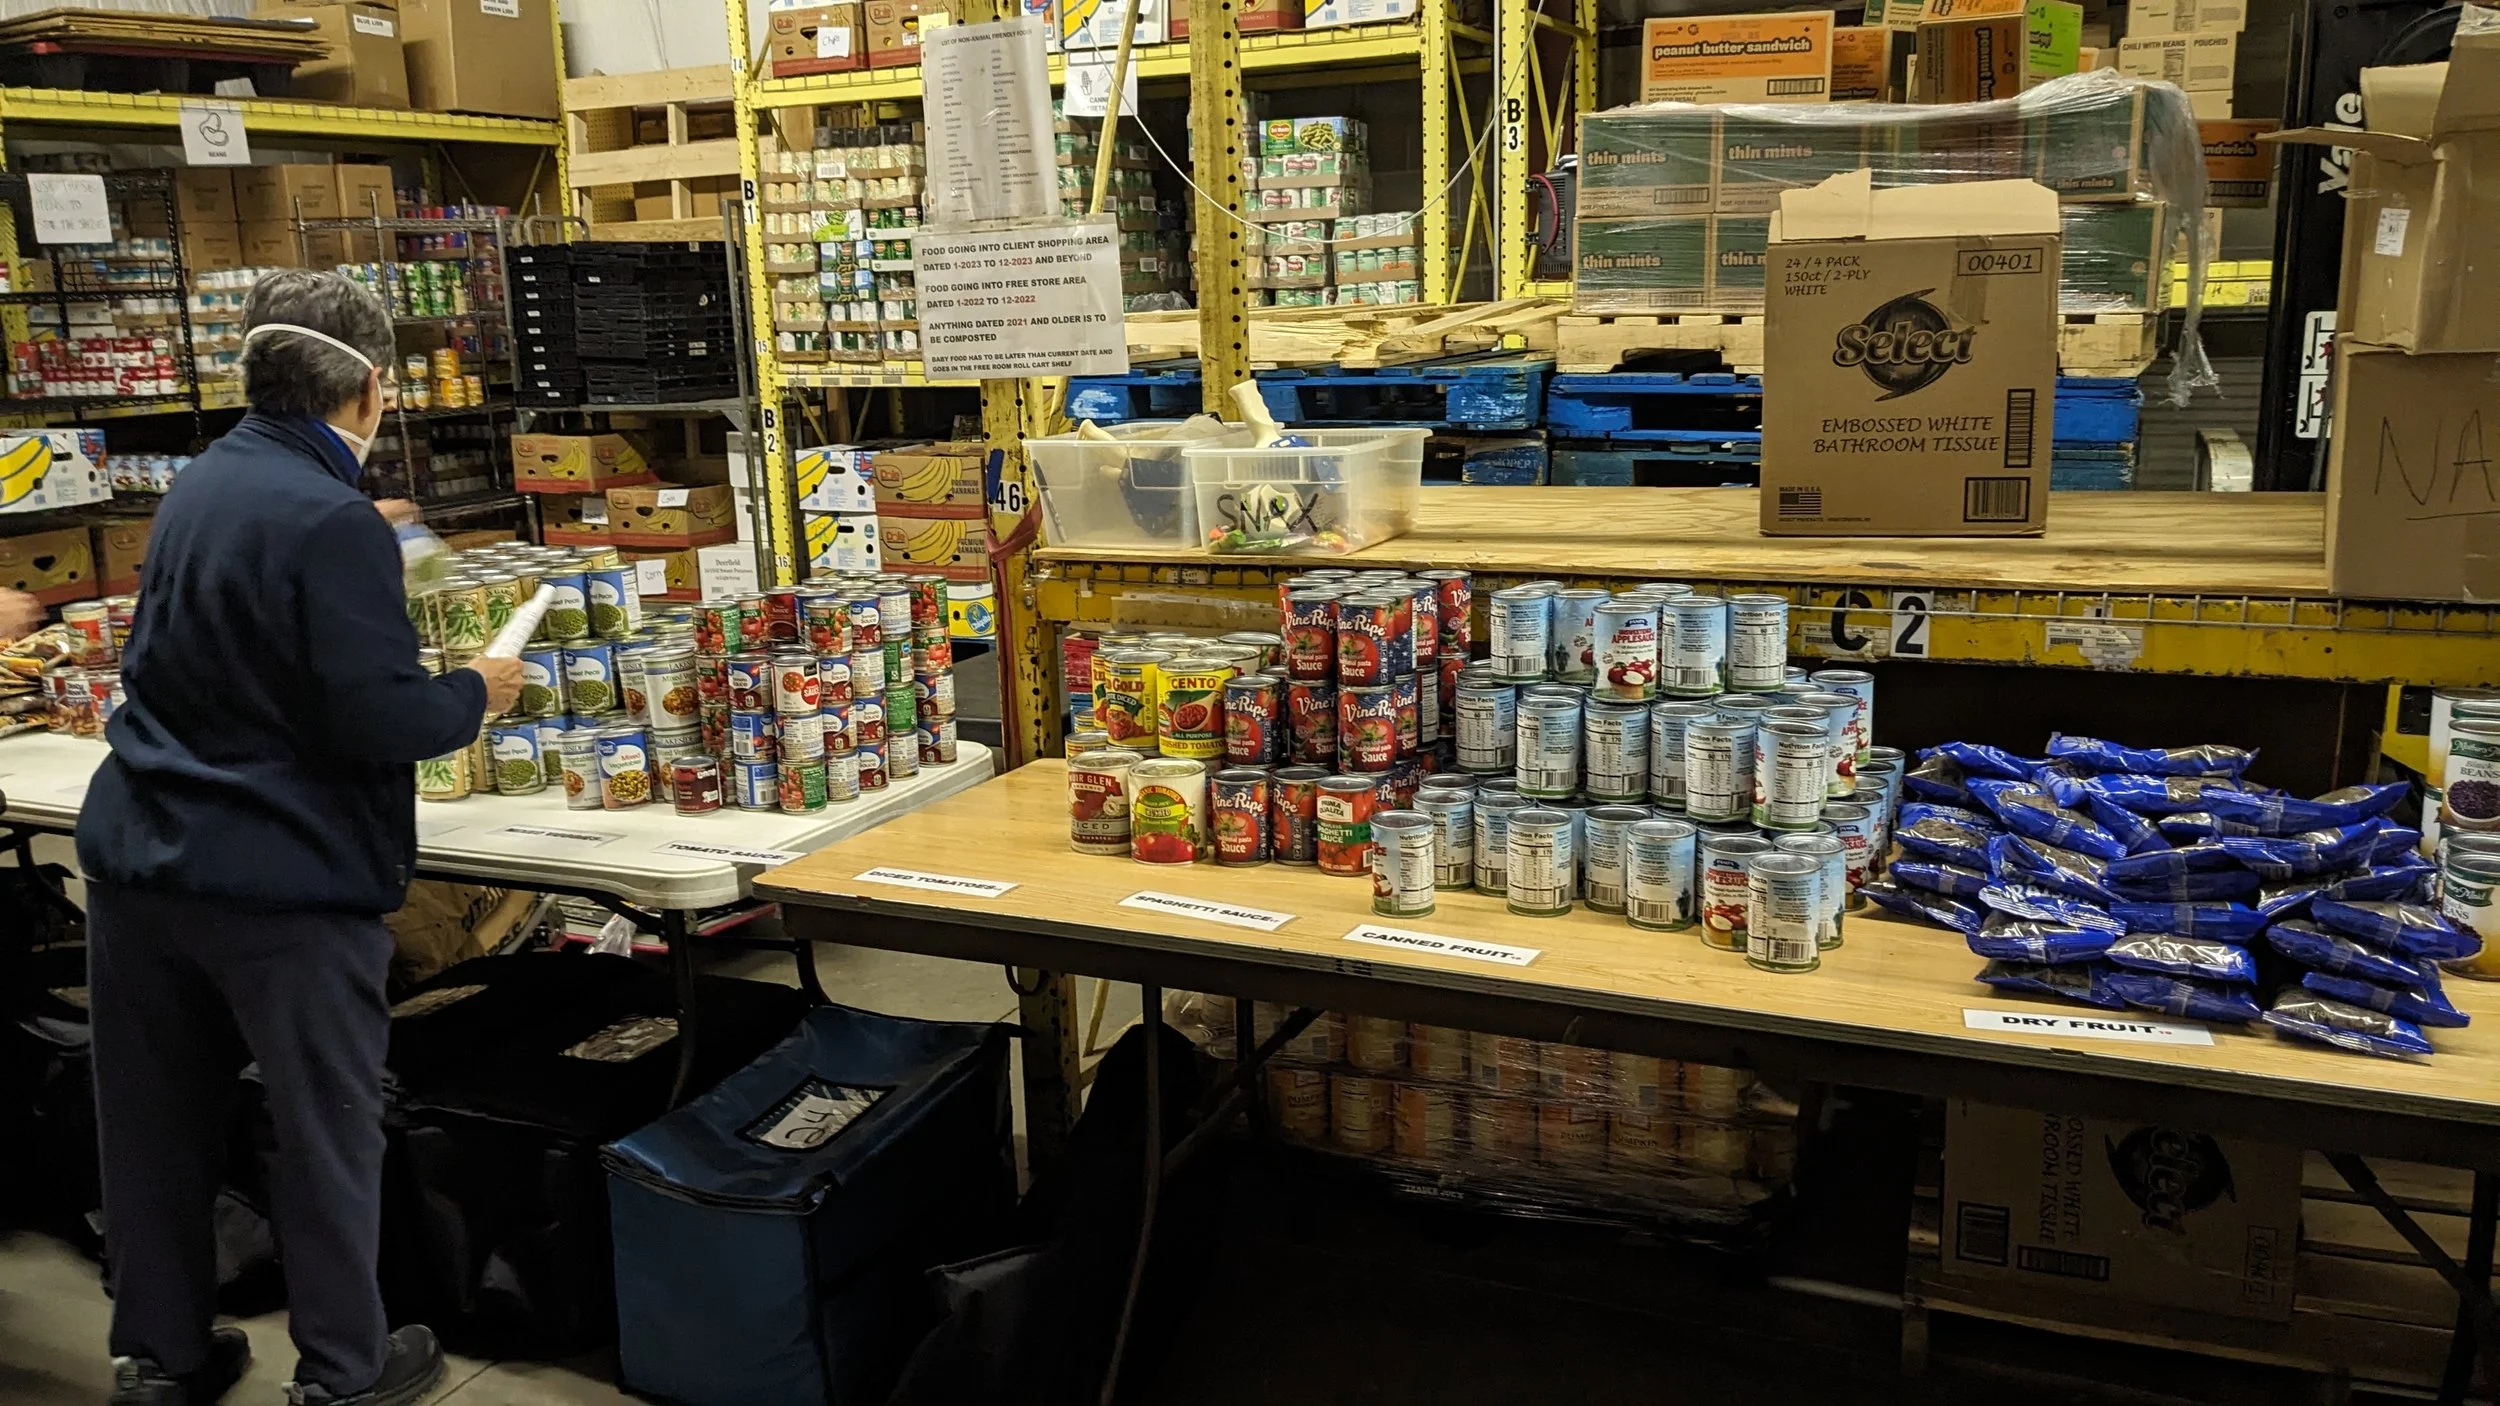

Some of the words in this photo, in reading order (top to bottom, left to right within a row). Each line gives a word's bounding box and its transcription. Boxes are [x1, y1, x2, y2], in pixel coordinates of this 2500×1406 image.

[958, 34, 991, 43] NON-ANIMAL
[992, 31, 1016, 39] FRIENDLY
[2194, 38, 2228, 48] POUCHED
[1654, 43, 1701, 60] peanut
[1702, 40, 1744, 55] butter
[1746, 36, 1810, 53] sandwich
[2162, 40, 2186, 48] BEANS
[1977, 29, 1993, 77] peanut
[733, 58, 742, 70] 14
[1507, 98, 1521, 123] B
[1508, 126, 1518, 150] 3
[1586, 150, 1618, 166] thin
[1620, 150, 1667, 164] mints
[1728, 144, 1762, 160] thin
[1764, 143, 1813, 158] mints
[744, 180, 755, 200] B
[748, 204, 754, 224] 1
[922, 248, 946, 256] FOOD
[948, 245, 976, 254] GOING
[978, 244, 1000, 252] INTO
[1002, 241, 1035, 250] CLIENT
[1037, 238, 1083, 248] SHOPPING
[1086, 236, 1110, 244] AREA
[923, 262, 950, 272] DATED
[953, 260, 982, 270] 1-2023
[984, 260, 996, 268] TO
[998, 257, 1033, 266] 12-2023
[1035, 256, 1054, 264] AND
[1056, 253, 1092, 263] BEYOND
[1582, 255, 1613, 269] thin
[1615, 254, 1662, 268] mints
[1720, 251, 1752, 267] thin
[1785, 258, 1800, 268] 24
[1804, 258, 1810, 268] /
[1813, 257, 1822, 268] 4
[1826, 256, 1860, 268] PACK
[1968, 254, 2033, 272] 00401
[1785, 272, 1822, 282] 150ct
[1824, 271, 1830, 282] /
[1833, 270, 1871, 282] 2-PLY
[925, 285, 948, 293] FOOD
[950, 282, 980, 292] GOING
[982, 281, 1003, 290] INTO
[1006, 279, 1029, 288] FREE
[1031, 278, 1061, 287] STORE
[1063, 276, 1087, 285] AREA
[1784, 285, 1828, 296] WHITE
[926, 300, 954, 308] DATED
[956, 298, 985, 307] 1-2022
[986, 297, 999, 305] TO
[1002, 295, 1036, 305] 12-2022
[929, 321, 974, 331] ANYTHING
[976, 319, 1005, 328] DATED
[1006, 318, 1028, 326] 2021
[1030, 317, 1050, 326] AND
[1051, 315, 1081, 324] OLDER
[1083, 314, 1092, 322] IS
[1094, 314, 1106, 322] TO
[930, 336, 942, 344] BE
[944, 334, 997, 343] COMPOSTED
[1833, 320, 1978, 368] Select
[758, 341, 768, 352] 15
[950, 354, 967, 362] FOOD
[1005, 352, 1026, 360] LATER
[1048, 350, 1079, 358] CURRENT
[1080, 349, 1098, 357] DATE
[1099, 348, 1113, 356] AND
[959, 364, 972, 372] THE
[1051, 360, 1072, 368] SHELF
[764, 409, 774, 428] B
[1822, 418, 1922, 434] EMBOSSED
[1928, 416, 1994, 431] WHITE
[767, 433, 775, 452] 2
[1813, 438, 1926, 453] BATHROOM
[1933, 436, 2001, 452] TISSUE
[880, 469, 900, 482] Dole
[952, 479, 978, 487] PREMIUM
[952, 487, 980, 496] BANANAS
[996, 482, 1022, 512] 46
[886, 530, 906, 544] Dole
[957, 538, 984, 546] PREMIUM
[956, 546, 986, 554] BANANAS
[778, 556, 788, 567] 16
[645, 571, 662, 580] Corn
[1286, 610, 1310, 630] Vine
[1355, 615, 1387, 638] Ripe
[1831, 591, 1872, 651] C
[1894, 596, 1928, 654] 2
[1612, 632, 1656, 644] APPLESAUCE
[1296, 660, 1322, 671] Sauce
[1342, 666, 1366, 678] Sauce
[586, 670, 600, 678] Peas
[1112, 678, 1146, 693] GOLD
[1171, 678, 1217, 690] CENTO
[1116, 694, 1137, 706] DICED
[1297, 697, 1329, 716] Vine
[1240, 696, 1269, 718] Ripe
[1344, 702, 1376, 723] Vine
[512, 748, 528, 756] Peas
[1228, 744, 1250, 756] Sauce
[1778, 742, 1812, 750] Nutrition
[620, 752, 642, 761] Mixed
[1362, 752, 1388, 763] Sauce
[610, 760, 642, 770] Vegetables
[2466, 760, 2494, 771] Black
[2460, 766, 2500, 779] BEANS
[1087, 776, 1112, 788] GLEN
[1235, 792, 1265, 814] Ripe
[1274, 788, 1298, 813] Ripe
[1320, 800, 1342, 810] PRIMA
[1320, 834, 1344, 844] SAUCE
[1400, 832, 1426, 841] Nutrition
[668, 844, 730, 855] TOMATO
[730, 852, 784, 860] SAUCE
[1220, 841, 1247, 854] Sauce
[869, 870, 914, 881] DICED
[917, 876, 996, 890] TOMATOES
[1134, 894, 1218, 914] SPAGHETTI
[1219, 909, 1272, 922] SAUCE
[1362, 931, 1446, 948] CANNED
[1448, 944, 1514, 960] FRUIT
[2002, 1016, 2060, 1027] DRY
[2069, 1020, 2157, 1034] FRUIT
